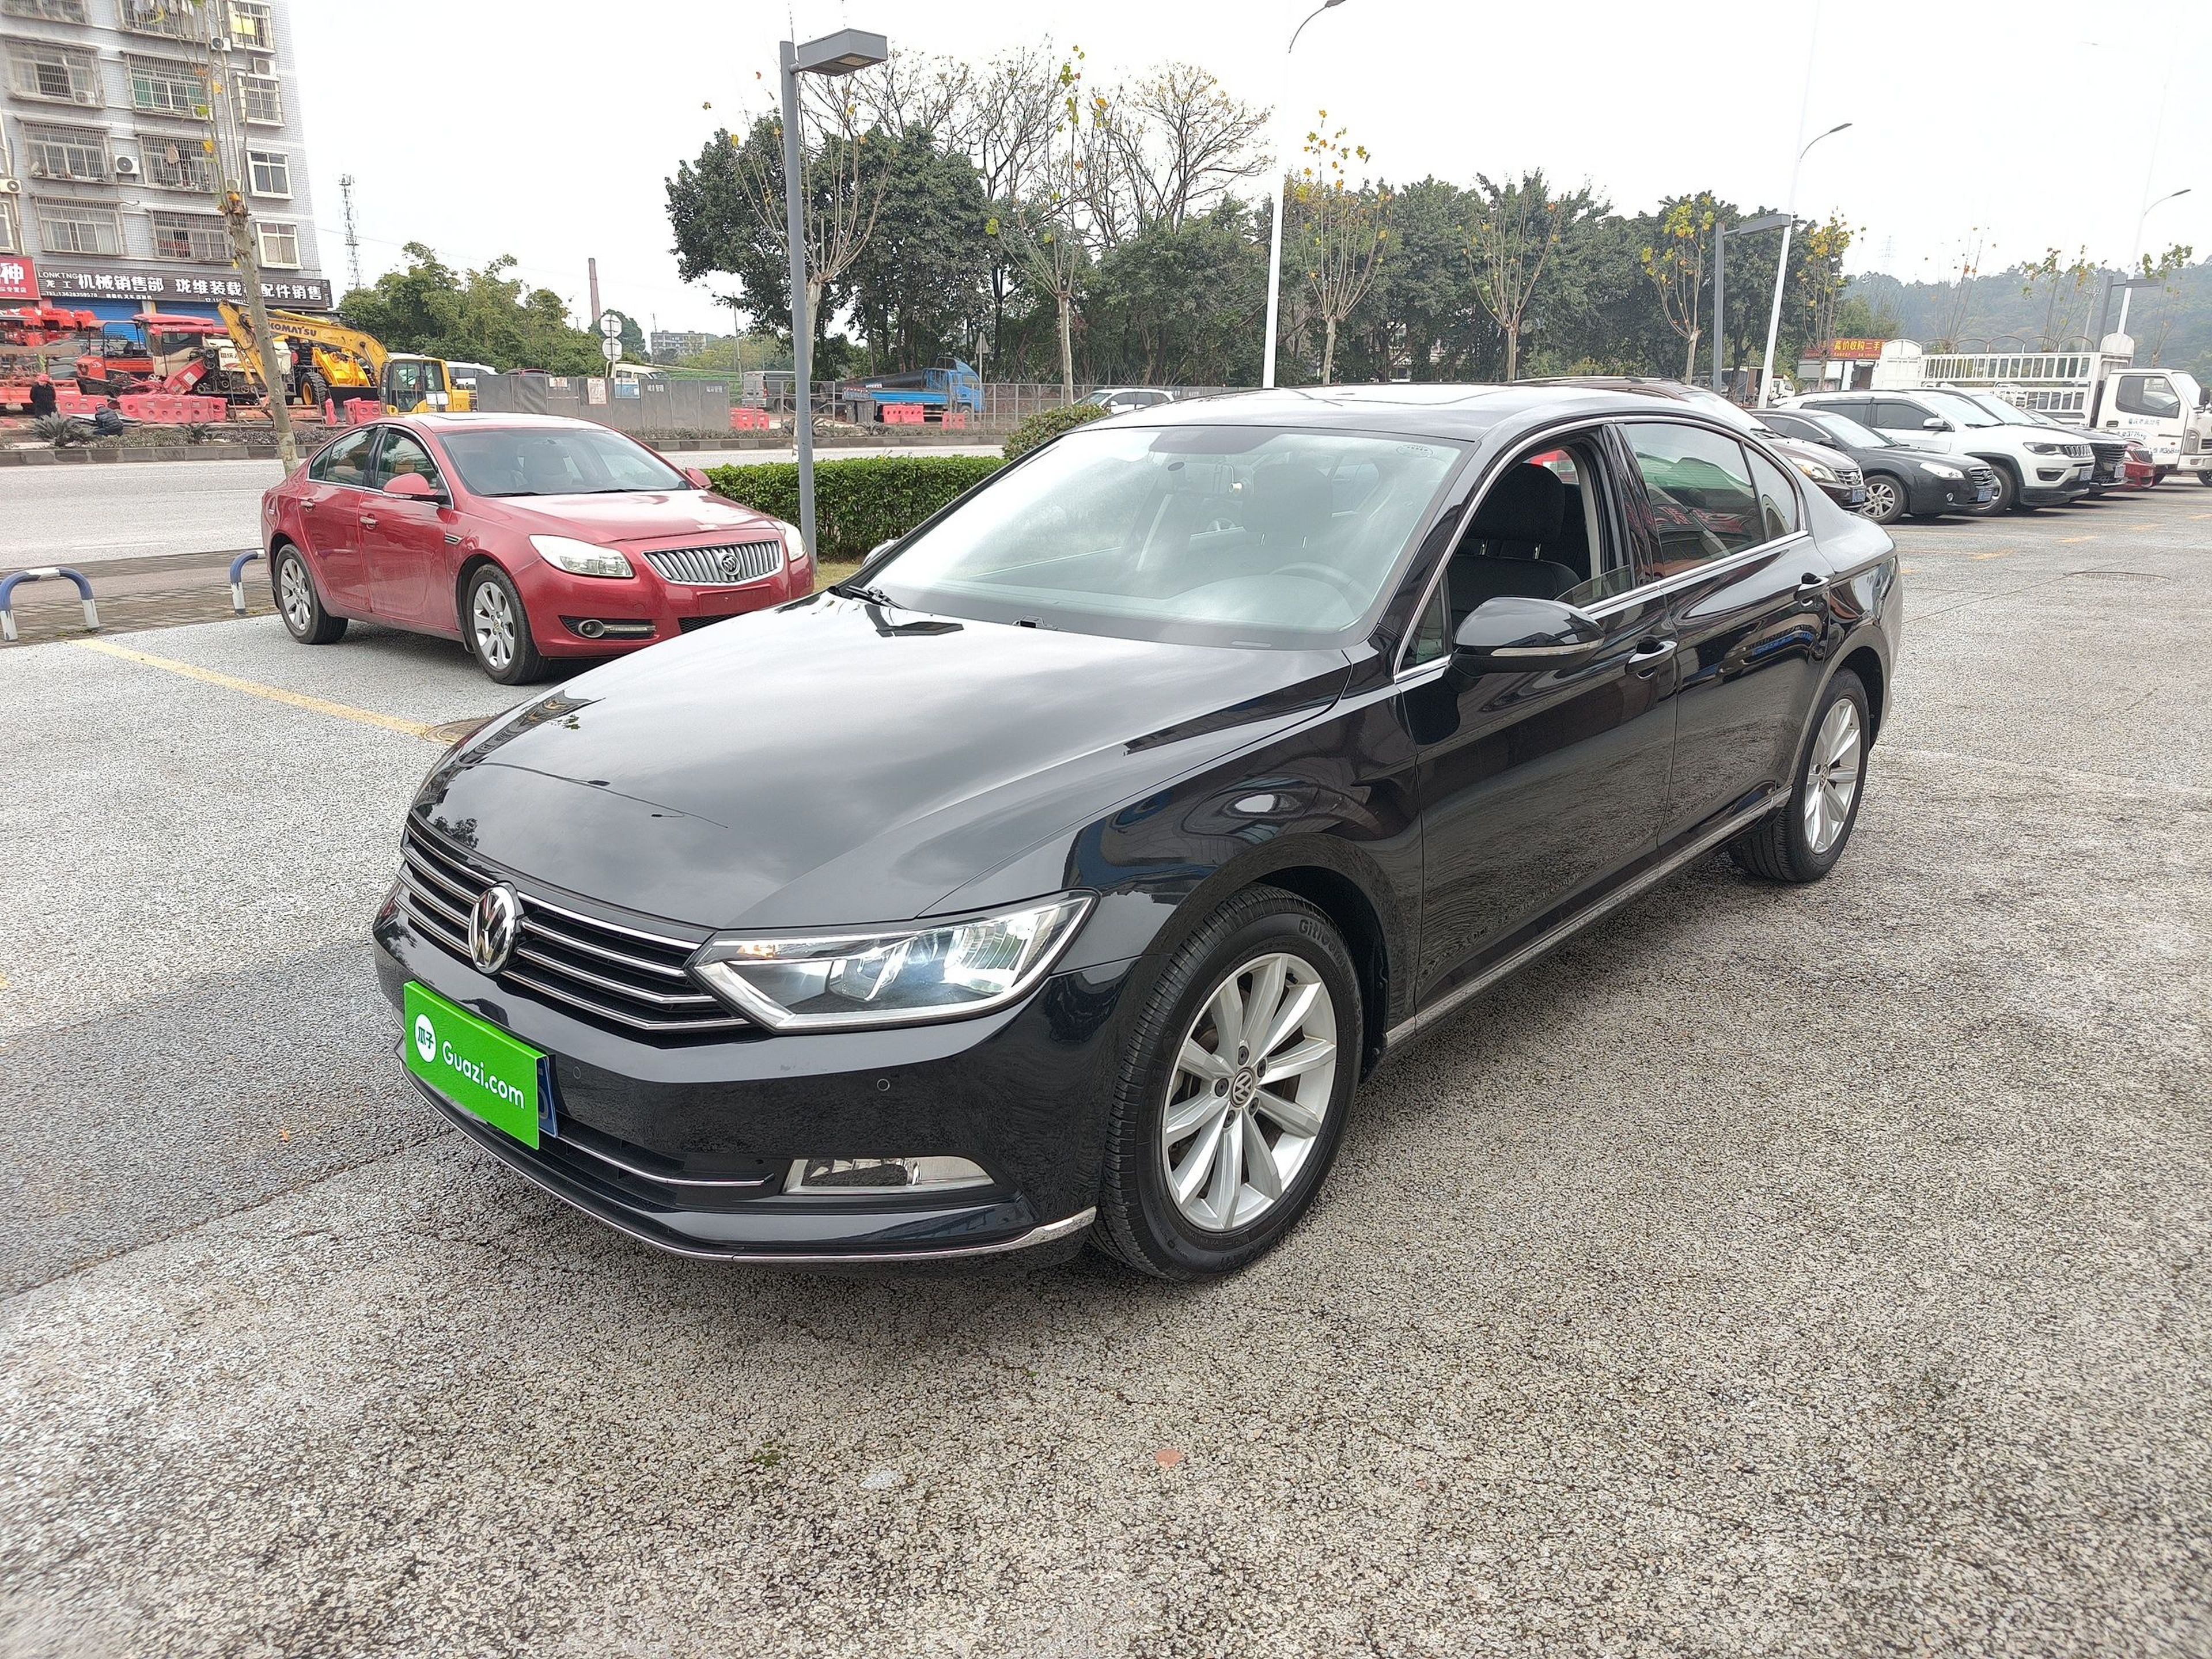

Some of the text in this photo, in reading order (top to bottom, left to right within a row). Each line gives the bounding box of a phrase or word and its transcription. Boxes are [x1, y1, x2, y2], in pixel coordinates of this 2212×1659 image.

[78, 274, 164, 292] 机械销售部
[268, 323, 317, 336] KOMATSU
[418, 1026, 434, 1049] 瓜子
[442, 1040, 525, 1109] Guazi.com
